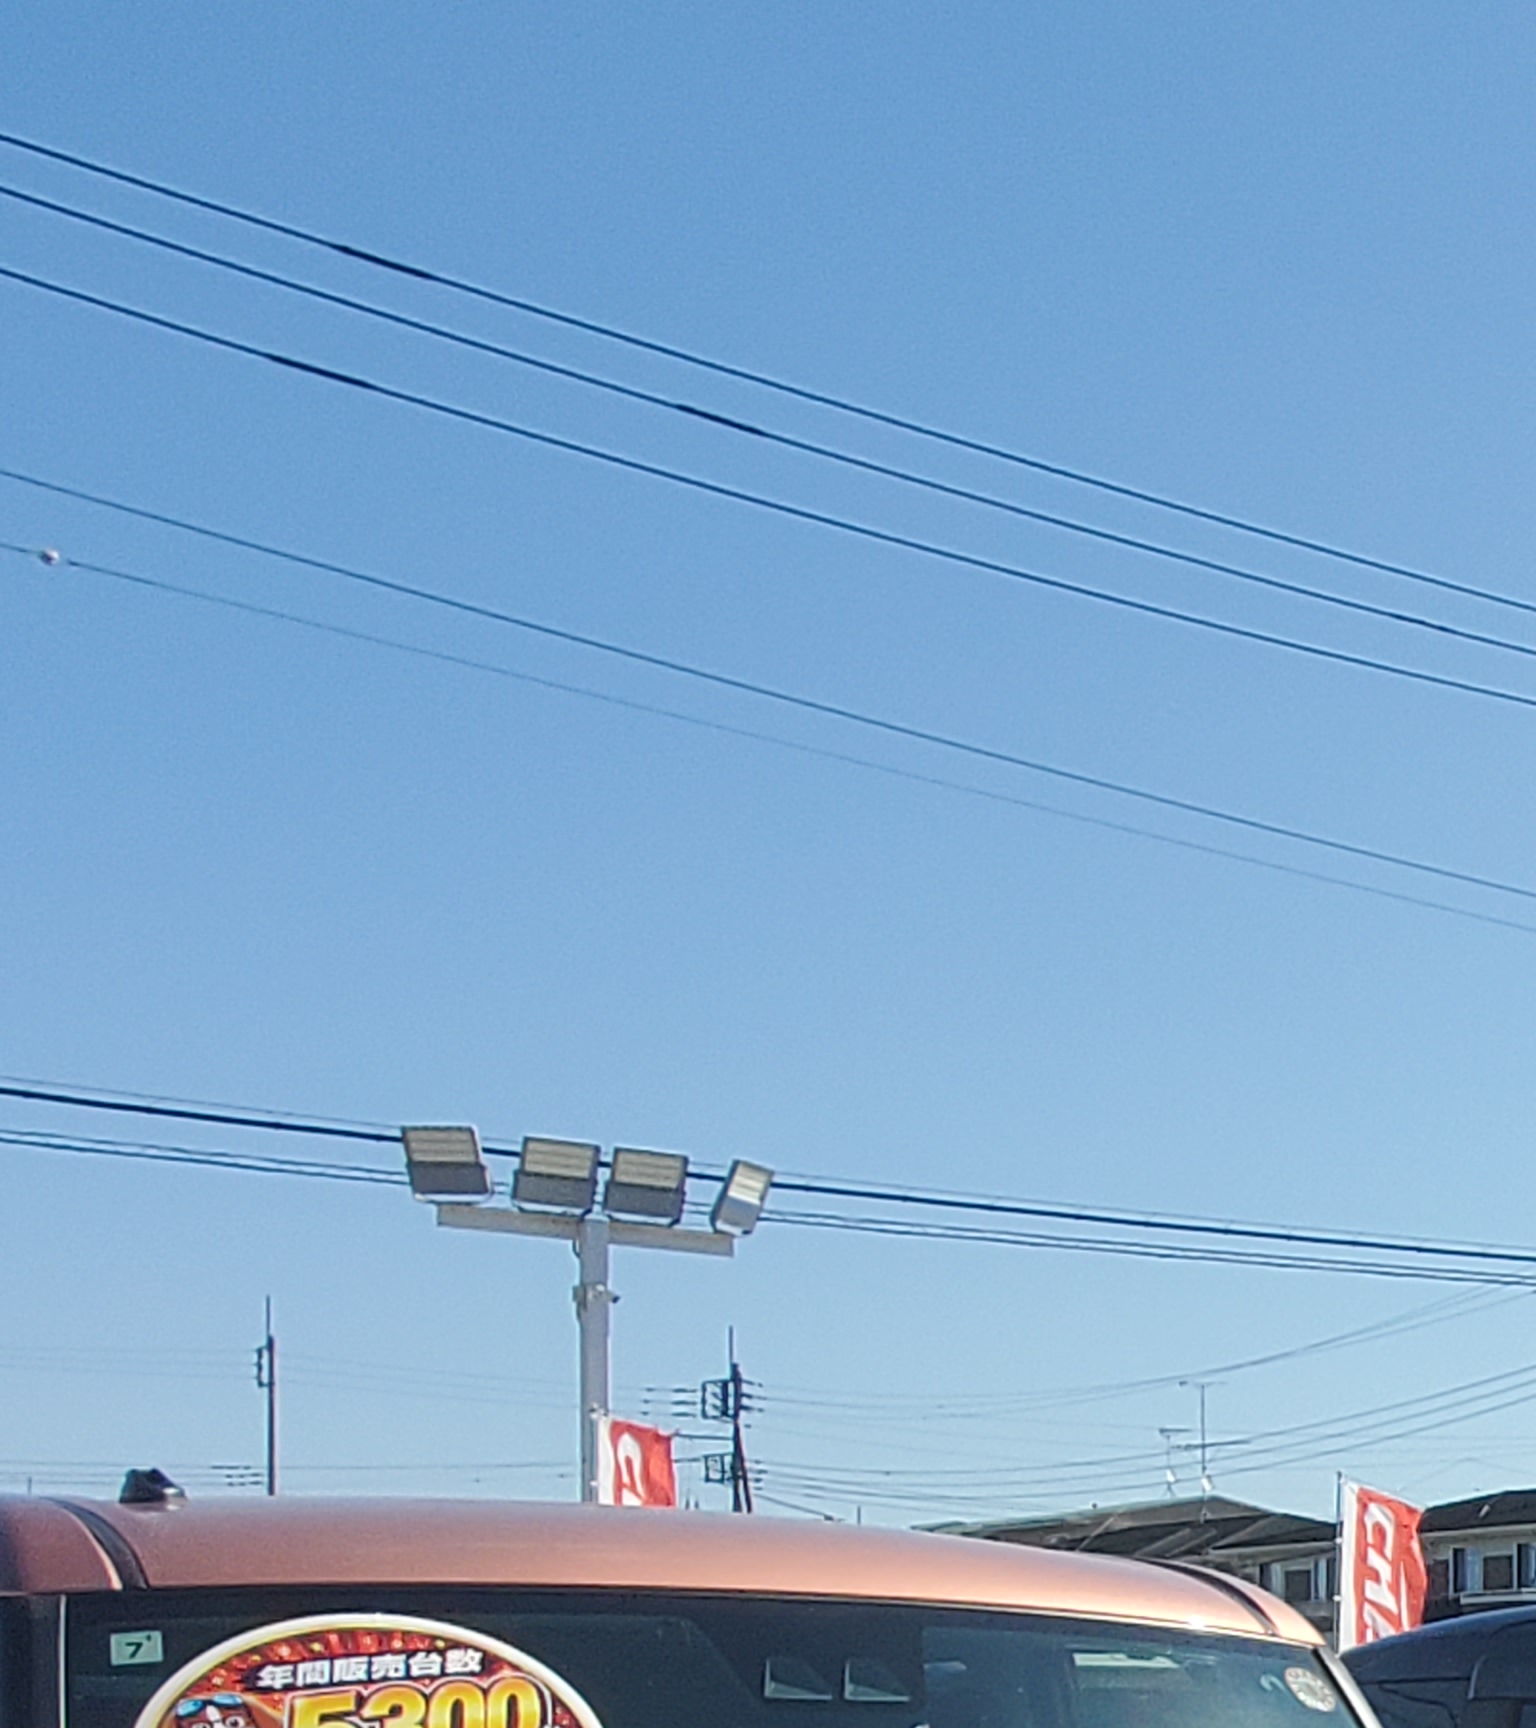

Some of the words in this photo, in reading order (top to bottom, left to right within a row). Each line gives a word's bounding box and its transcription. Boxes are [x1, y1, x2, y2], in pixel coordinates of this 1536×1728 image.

[255, 1648, 484, 1690] 年間販売台数
